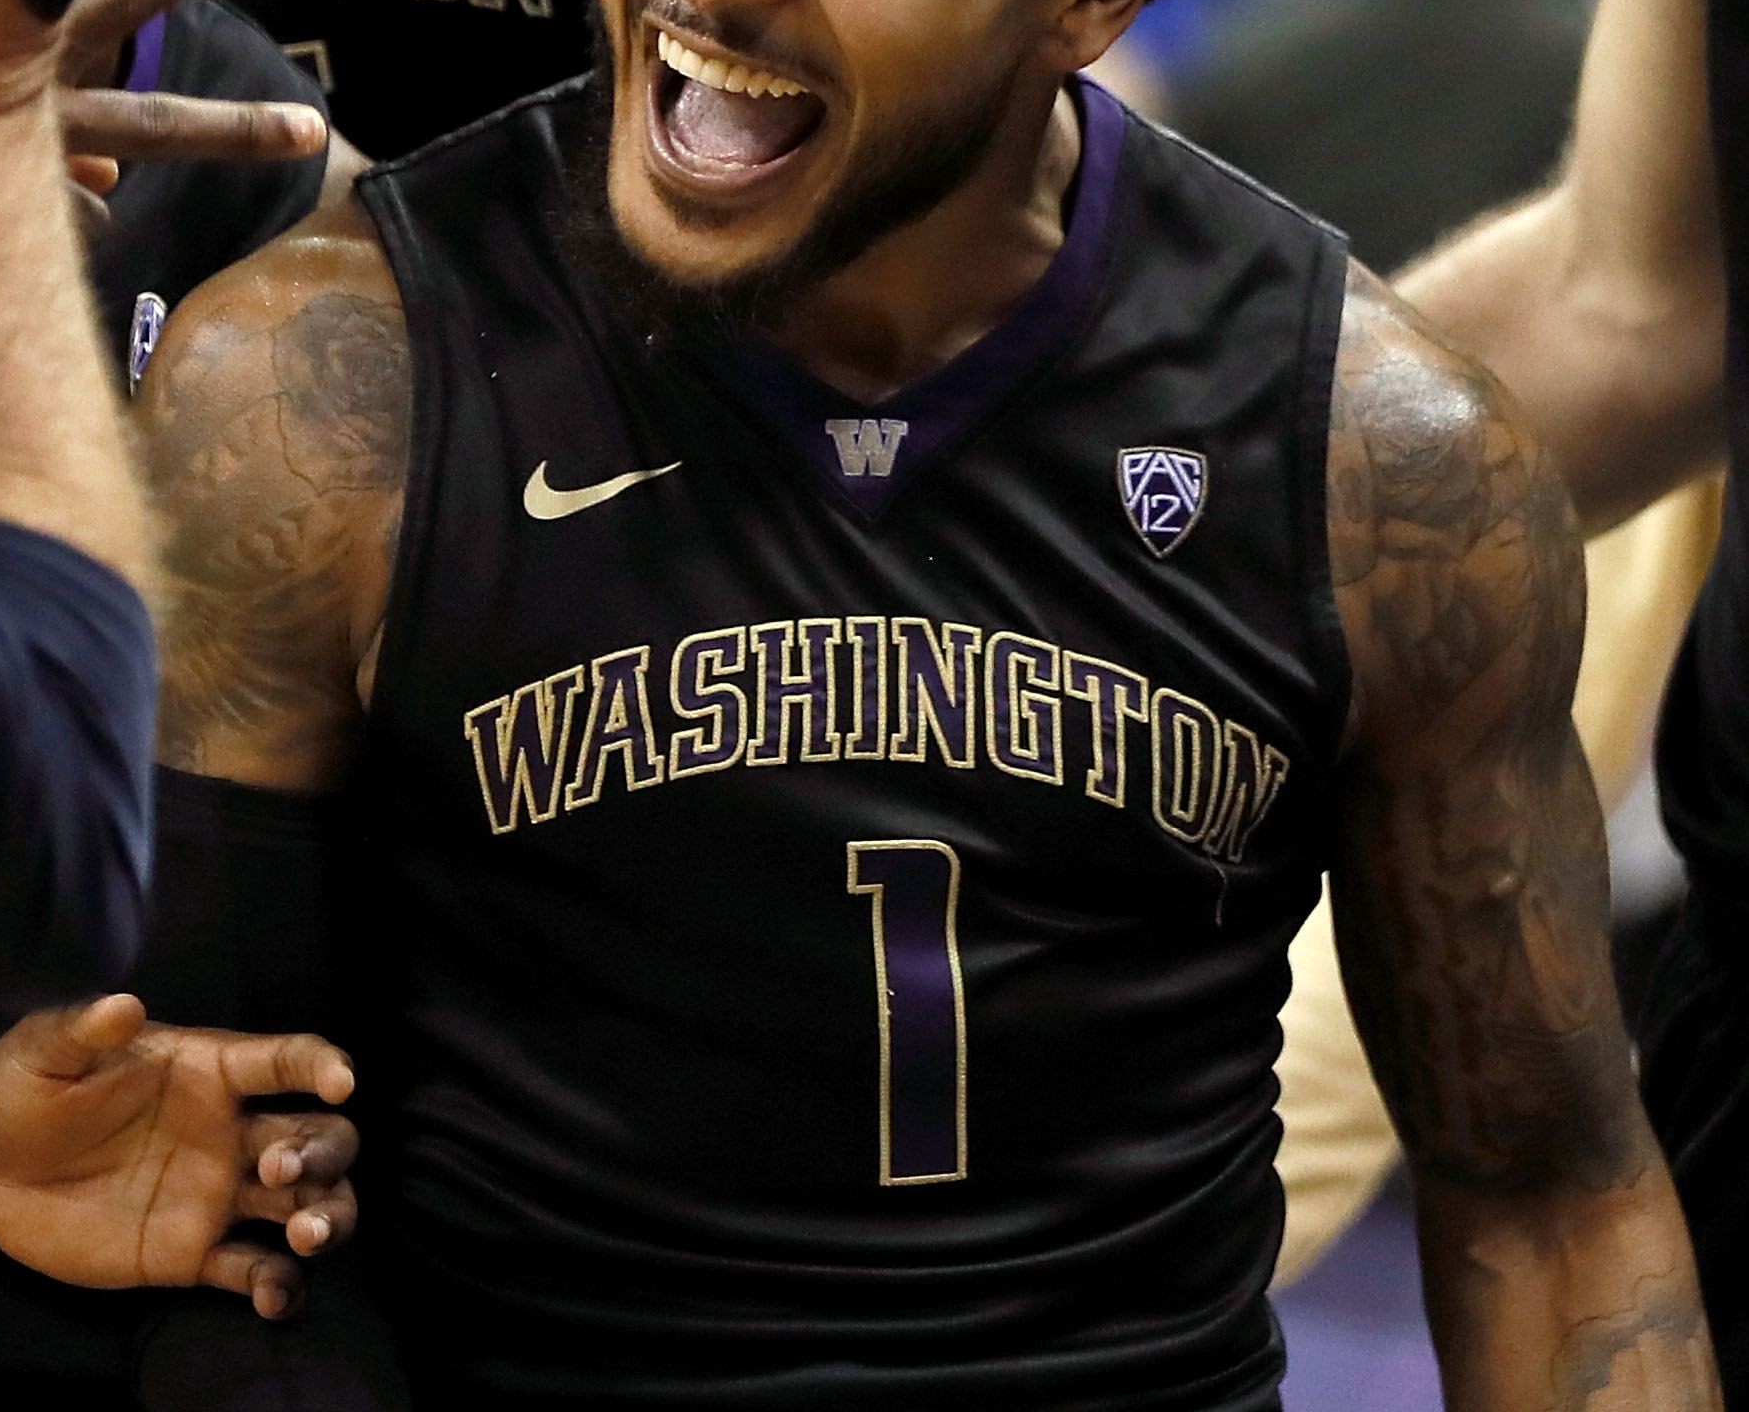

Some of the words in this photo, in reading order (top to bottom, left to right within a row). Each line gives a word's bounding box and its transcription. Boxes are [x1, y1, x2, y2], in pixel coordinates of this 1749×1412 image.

[824, 418, 909, 476] W
[1122, 451, 1201, 513] PAC
[1141, 493, 1183, 533] 12
[464, 615, 1291, 864] WASHINGTON
[847, 839, 968, 1187] 1
